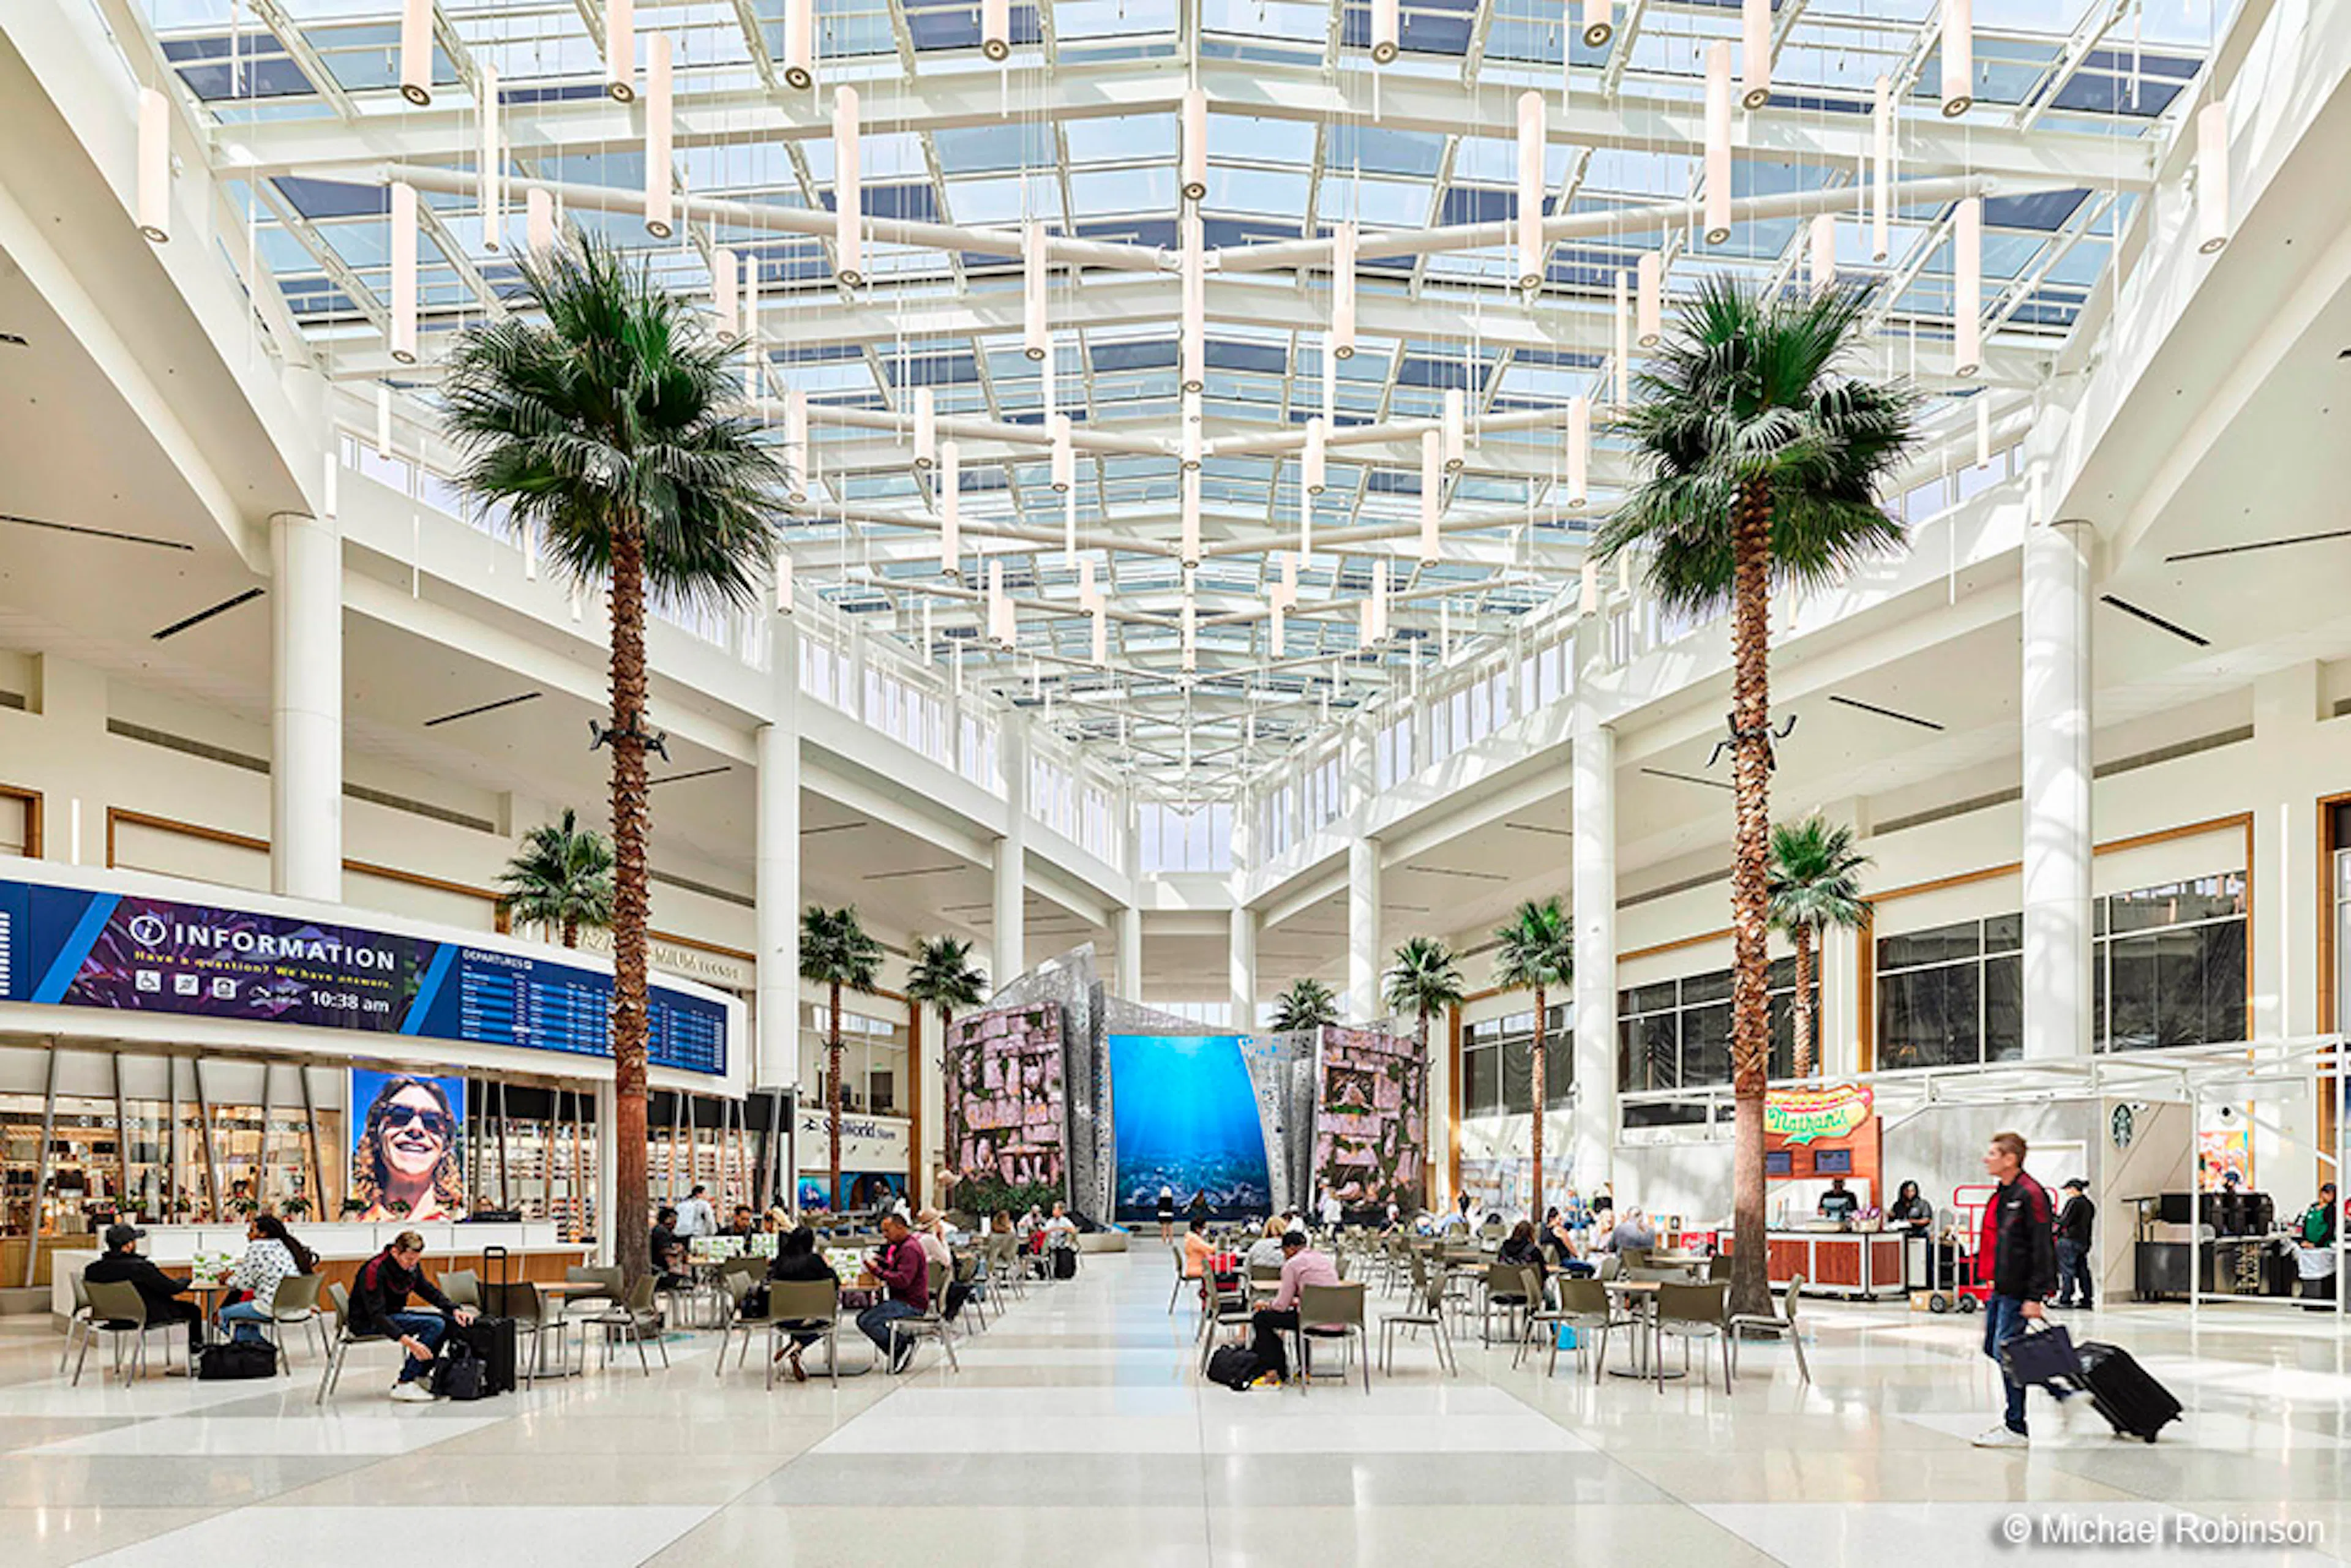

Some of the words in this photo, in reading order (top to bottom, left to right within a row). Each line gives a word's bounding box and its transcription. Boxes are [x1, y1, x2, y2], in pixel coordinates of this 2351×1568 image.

[174, 922, 395, 971] INFORMATION
[462, 948, 523, 969] DEPARTURES
[134, 950, 174, 963] Have
[194, 959, 270, 975] question?
[300, 969, 333, 982] have
[337, 976, 394, 990] answers.
[310, 991, 359, 1010] 10:38
[362, 998, 389, 1013] am
[1768, 1107, 1847, 1132] Nathan's
